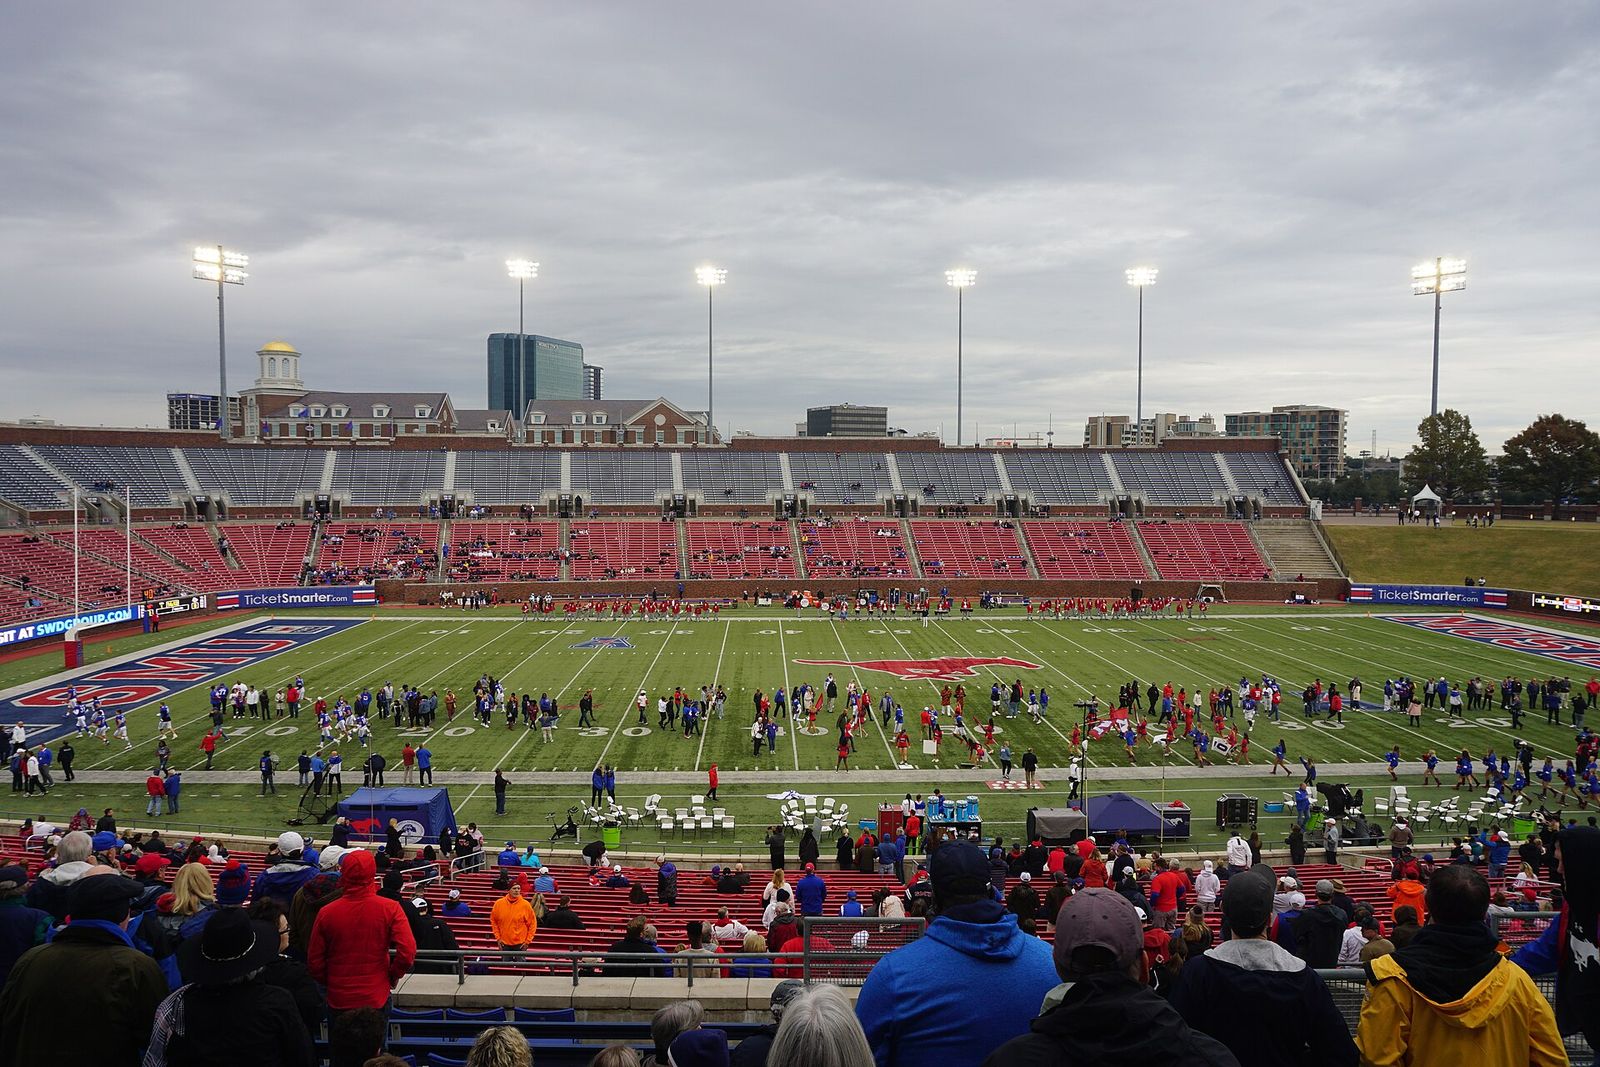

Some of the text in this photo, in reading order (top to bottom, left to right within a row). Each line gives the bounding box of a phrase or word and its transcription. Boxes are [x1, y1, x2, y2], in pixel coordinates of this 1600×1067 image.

[244, 592, 348, 605] TicketSmarter.com
[1378, 589, 1479, 603] TicketSmarter.com
[18, 626, 35, 640] AT
[10, 638, 299, 707] SMU
[1435, 717, 1514, 728] 20
[397, 726, 475, 737] 20
[578, 726, 653, 737] 30
